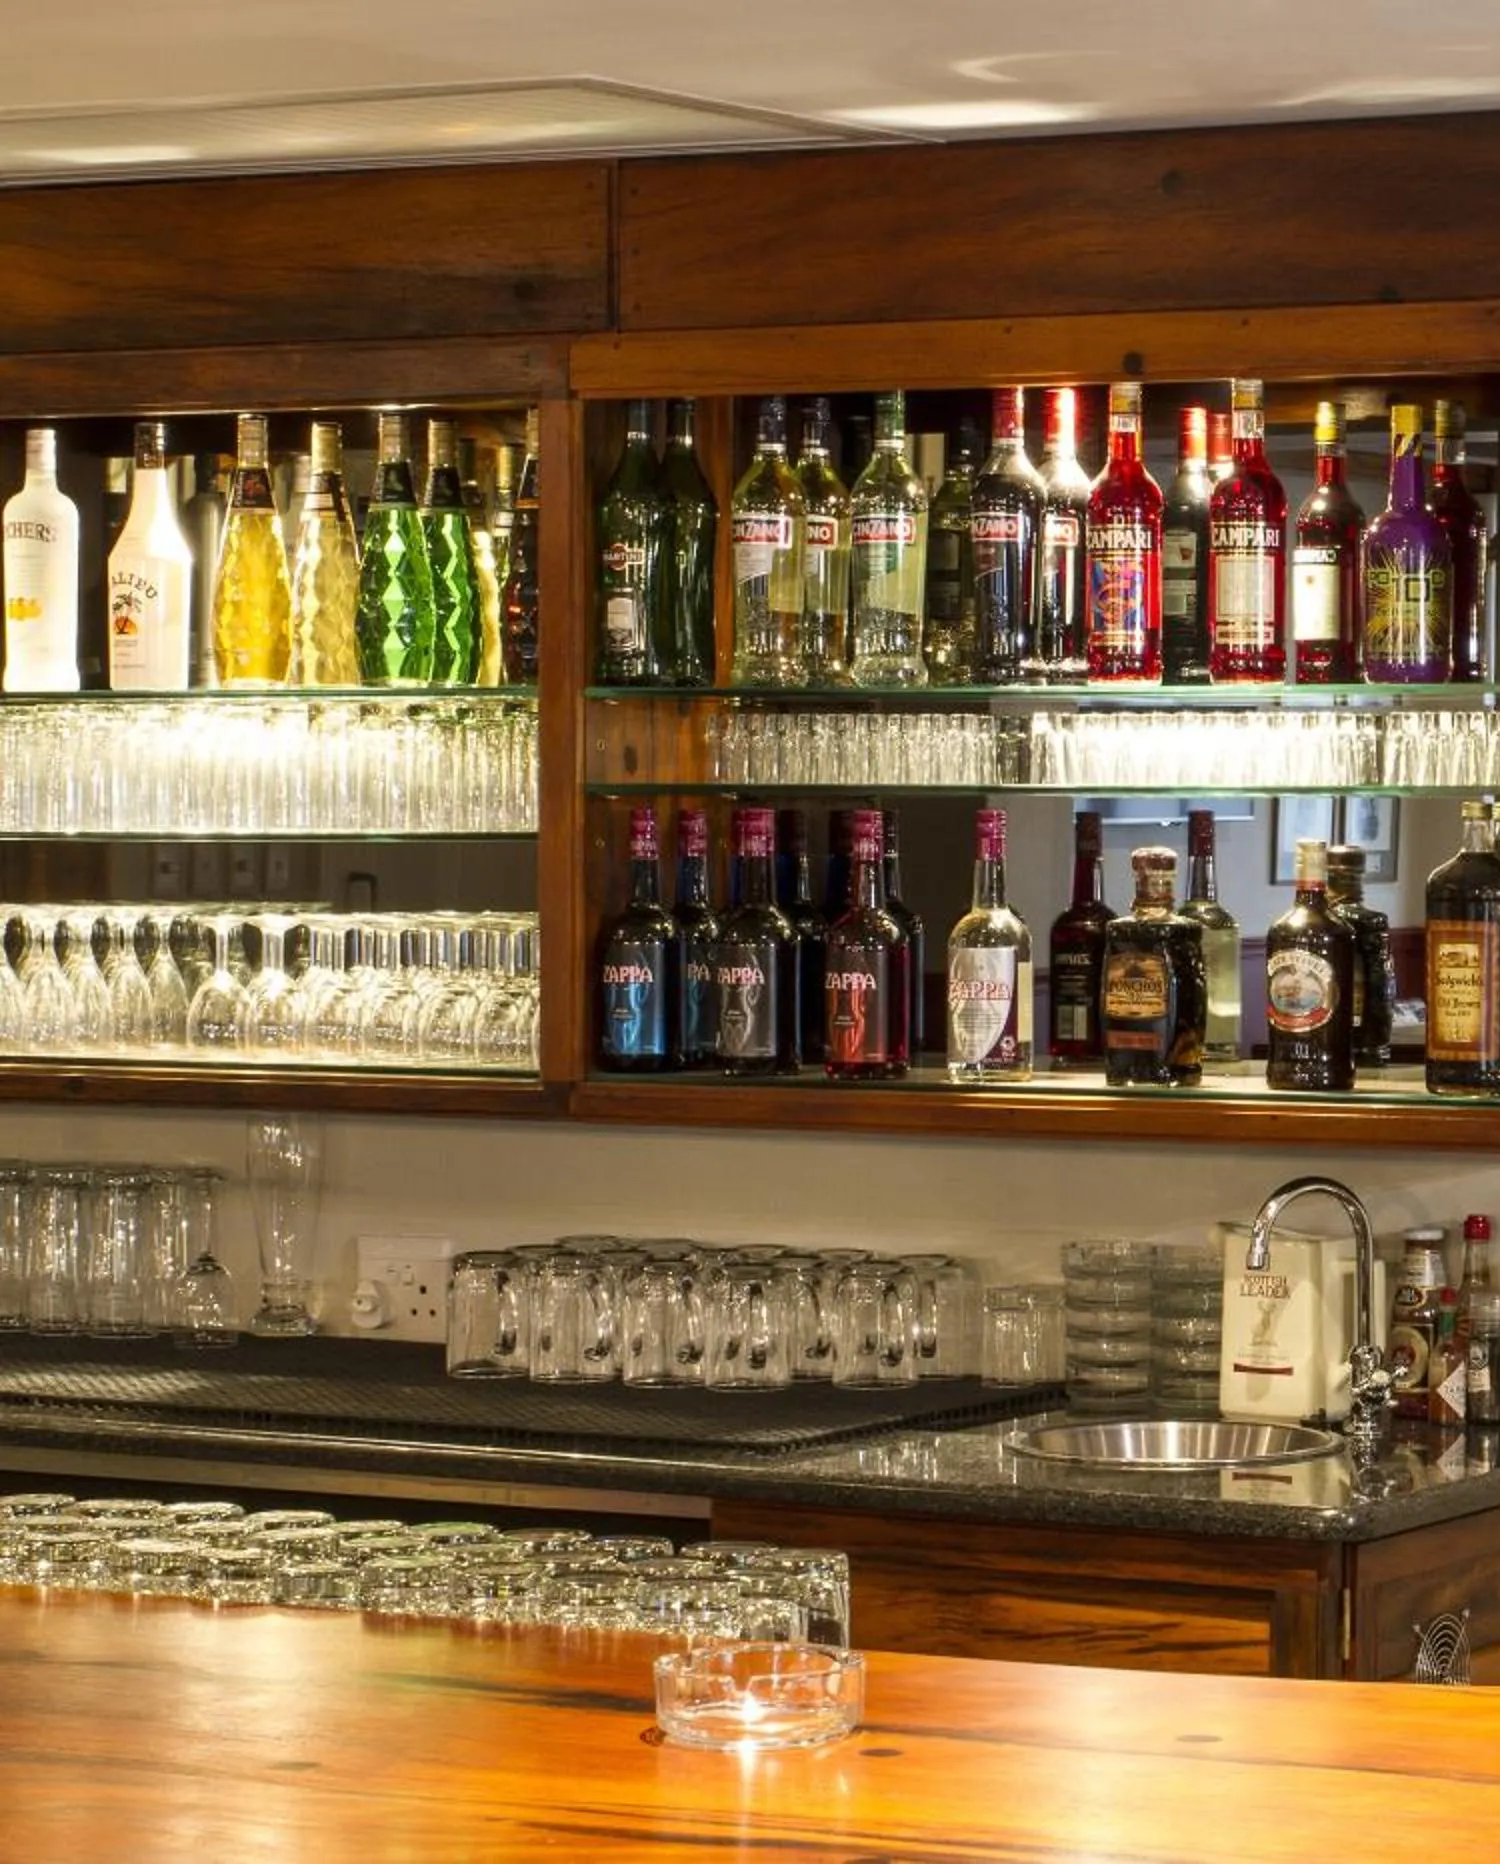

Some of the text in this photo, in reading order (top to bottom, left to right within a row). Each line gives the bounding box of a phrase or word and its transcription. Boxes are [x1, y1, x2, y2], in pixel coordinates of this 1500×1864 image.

[6, 521, 57, 543] CHERS
[1212, 528, 1280, 547] CAMPARI
[603, 963, 654, 984] ZAPPA
[825, 972, 877, 990] ZAPPA
[949, 977, 1011, 1001] ZAPPA
